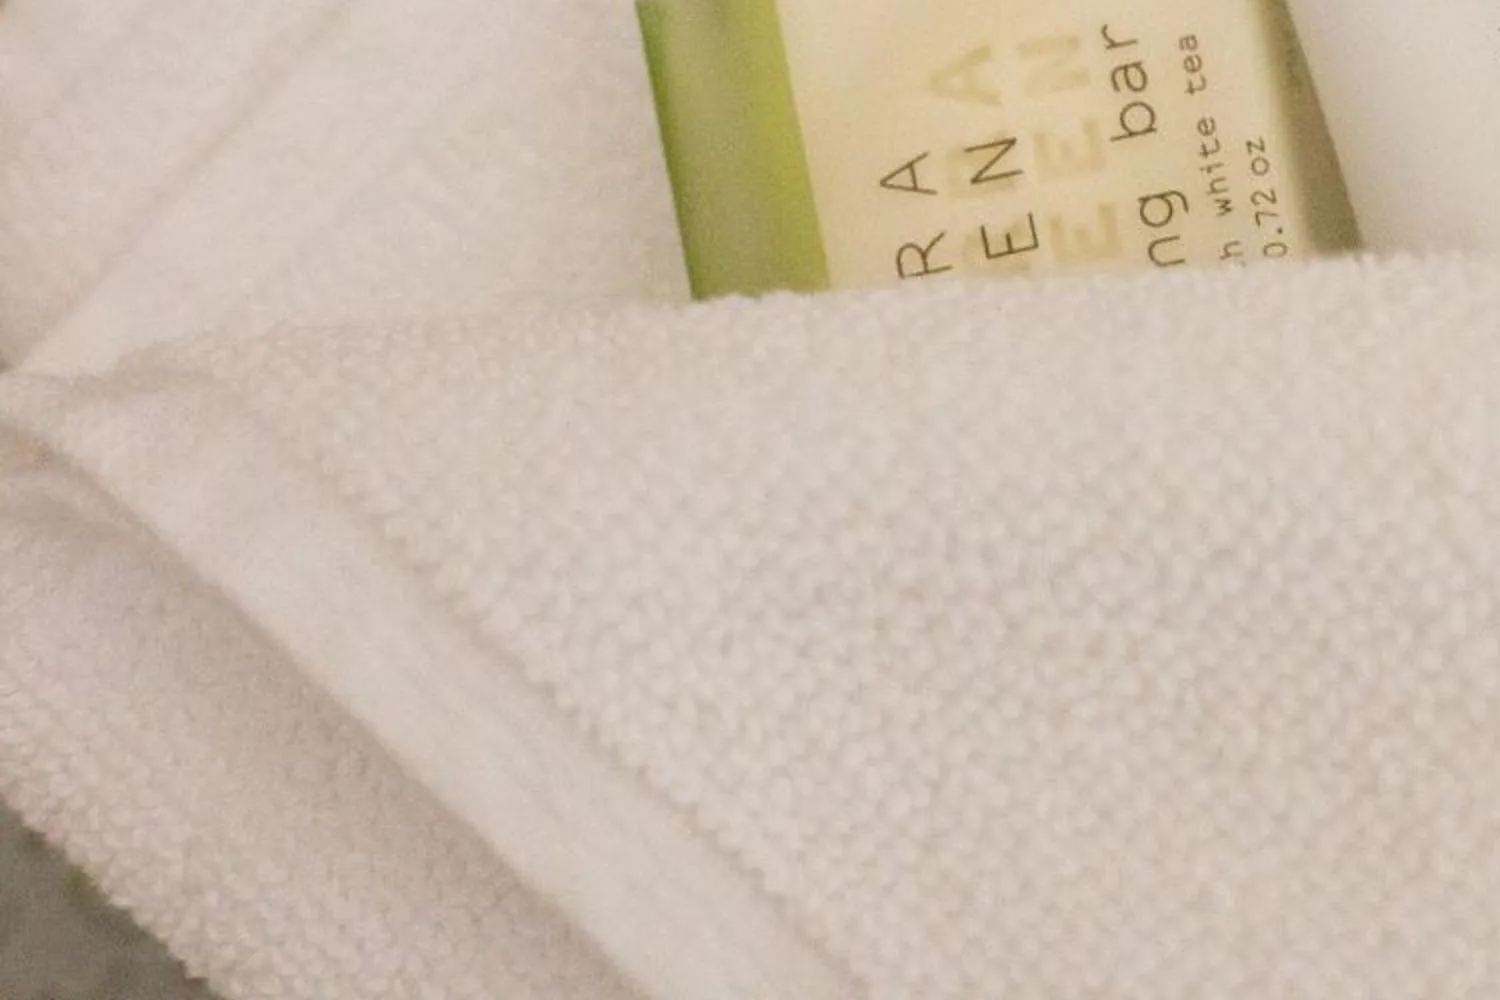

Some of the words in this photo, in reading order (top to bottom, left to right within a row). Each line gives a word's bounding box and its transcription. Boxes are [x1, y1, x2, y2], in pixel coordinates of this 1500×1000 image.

[1101, 24, 1157, 142] bar
[1179, 35, 1207, 95] tea
[1197, 117, 1233, 217] white
[1246, 137, 1270, 176] oz
[1252, 189, 1288, 257] 0.72
